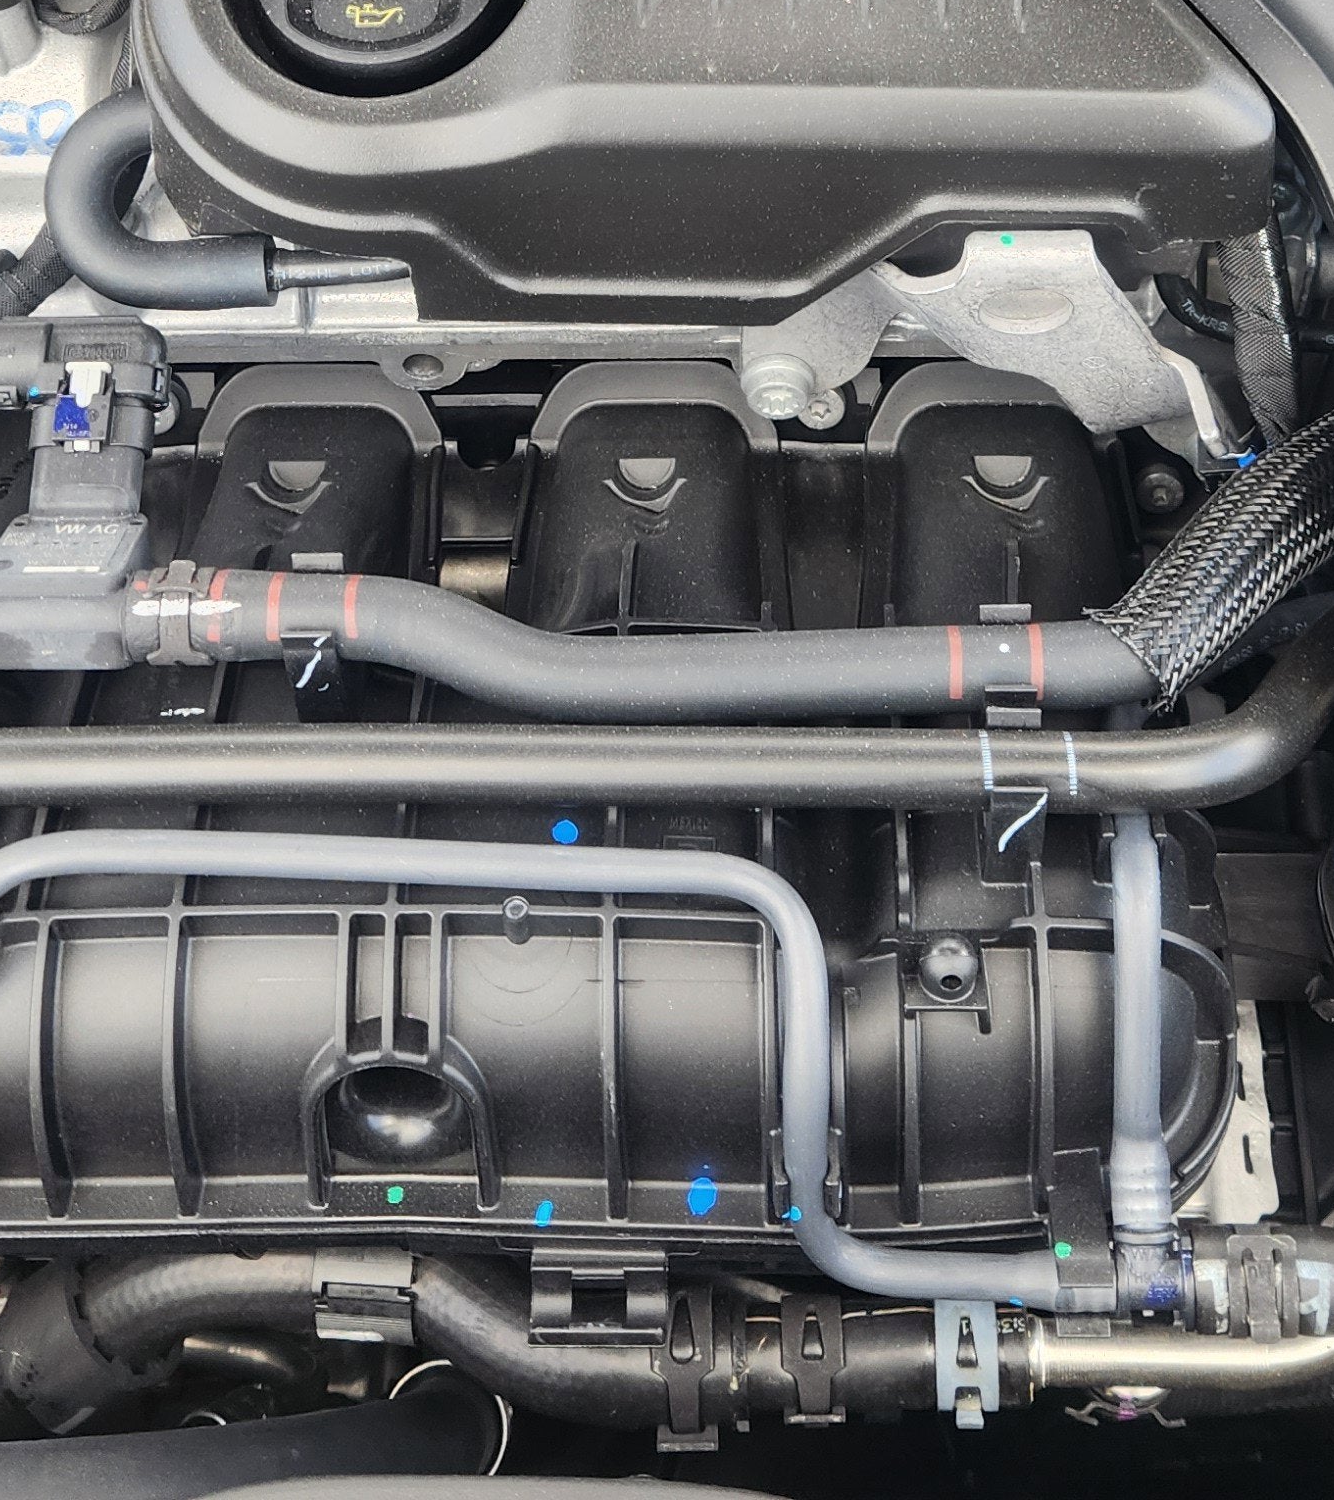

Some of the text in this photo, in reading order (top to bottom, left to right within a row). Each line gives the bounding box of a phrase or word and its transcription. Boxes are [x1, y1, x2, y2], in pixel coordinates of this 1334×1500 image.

[1181, 298, 1229, 333] TR-KRS
[55, 523, 119, 534] VW AG
